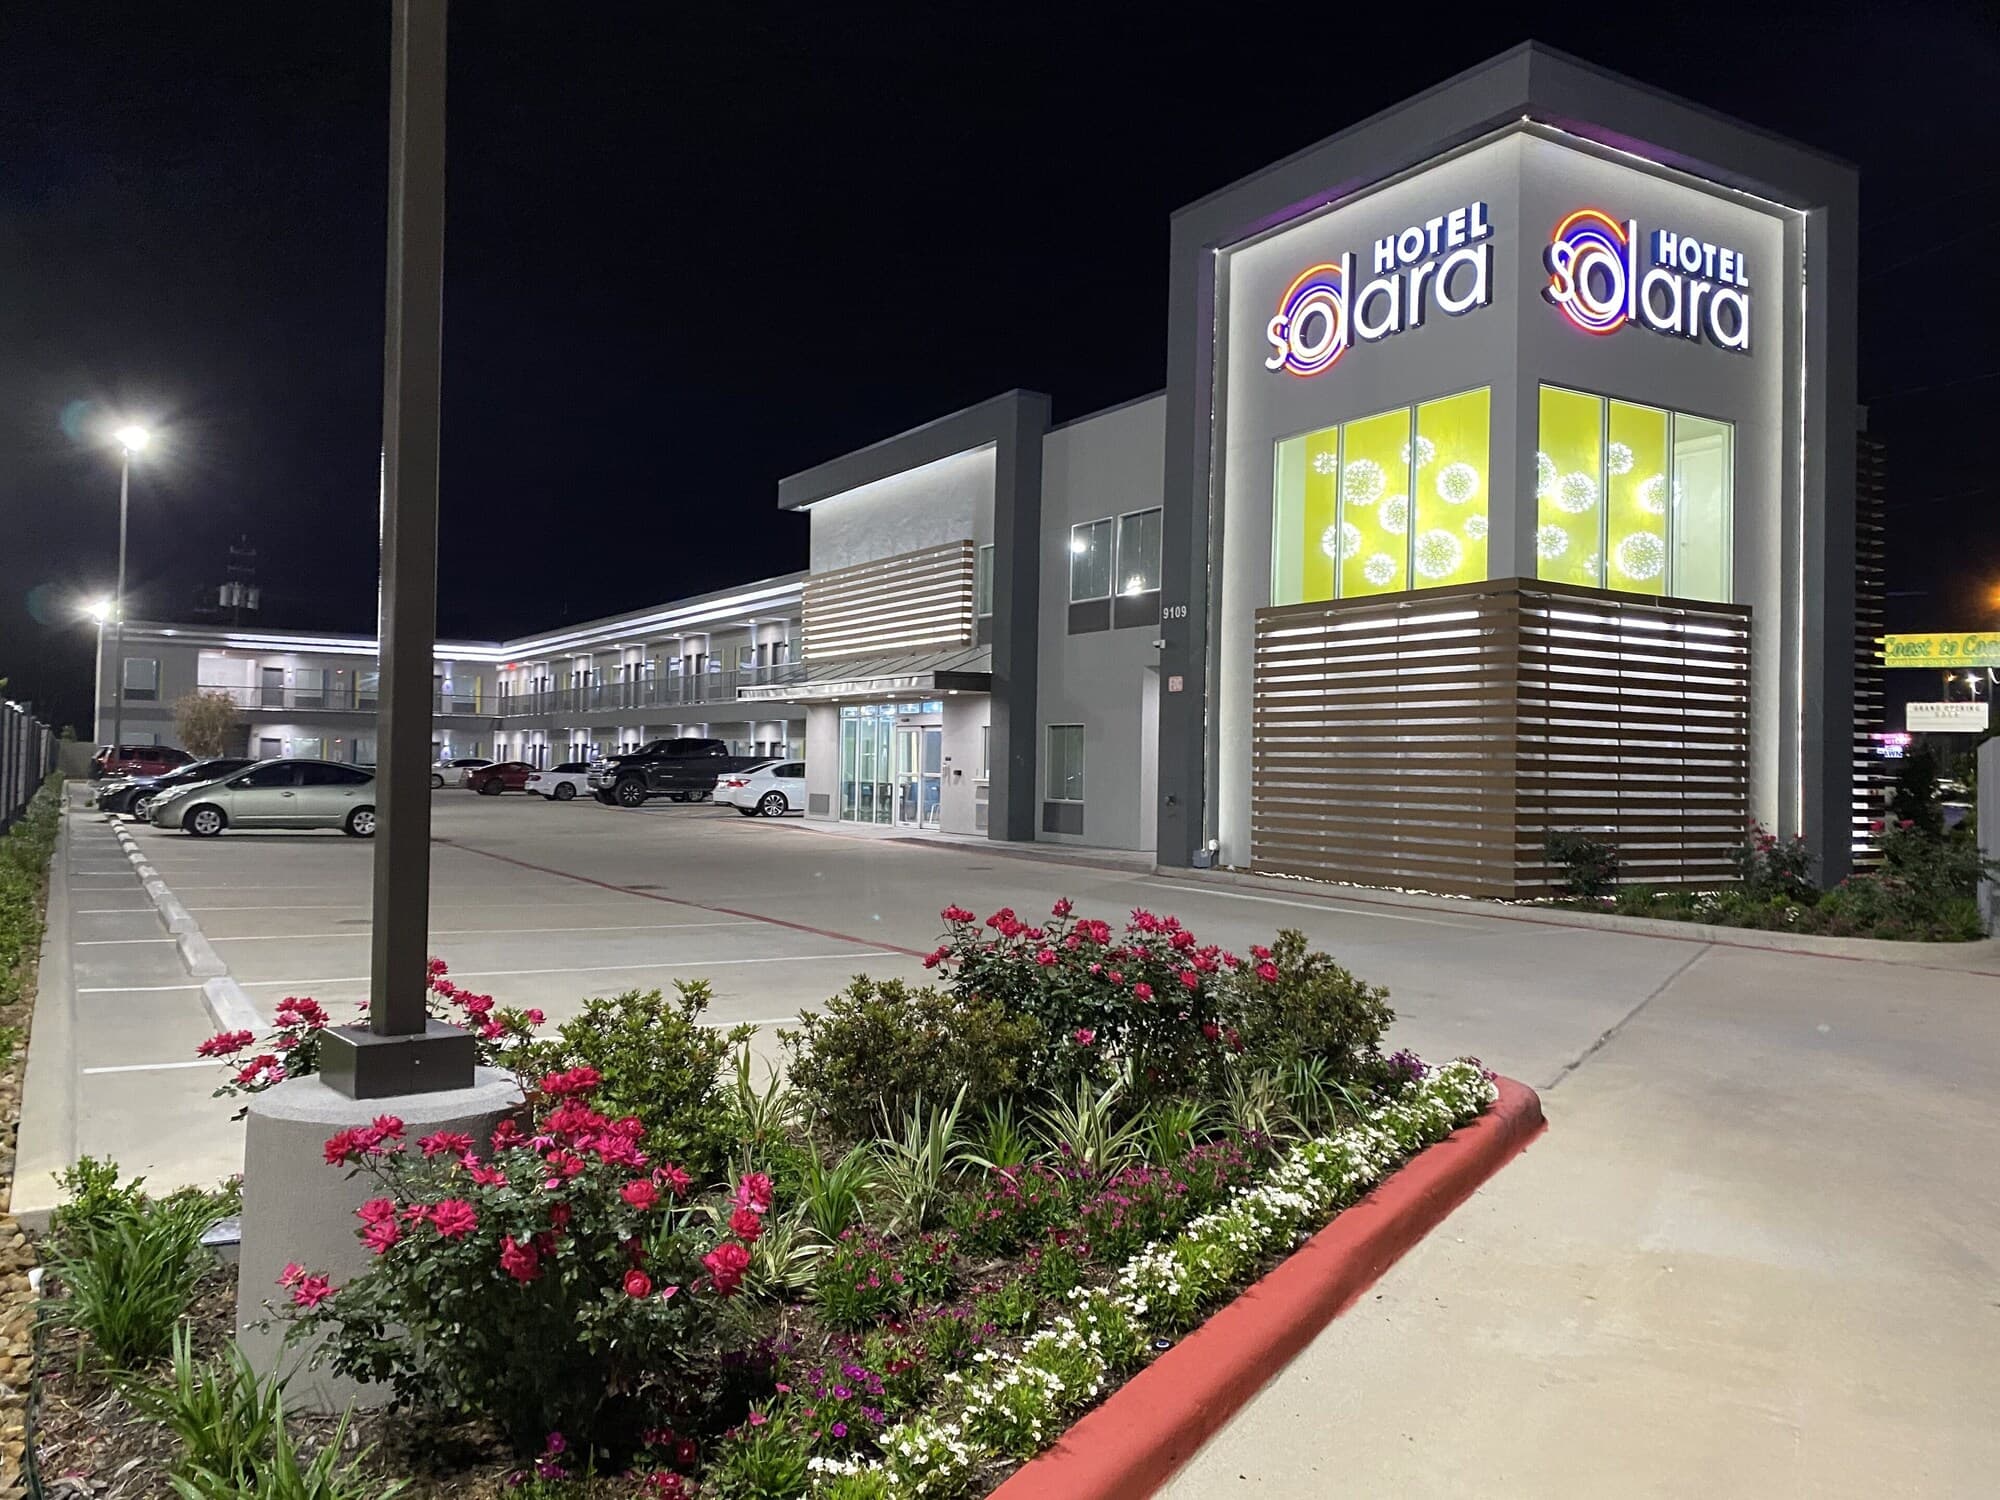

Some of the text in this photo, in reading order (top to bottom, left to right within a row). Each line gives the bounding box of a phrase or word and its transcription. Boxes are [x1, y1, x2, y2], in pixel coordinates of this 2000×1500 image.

[1374, 202, 1490, 274] HOTEL
[1654, 228, 1749, 288] HOTEL
[1163, 605, 1187, 619] 9109
[1939, 638, 1959, 656] to
